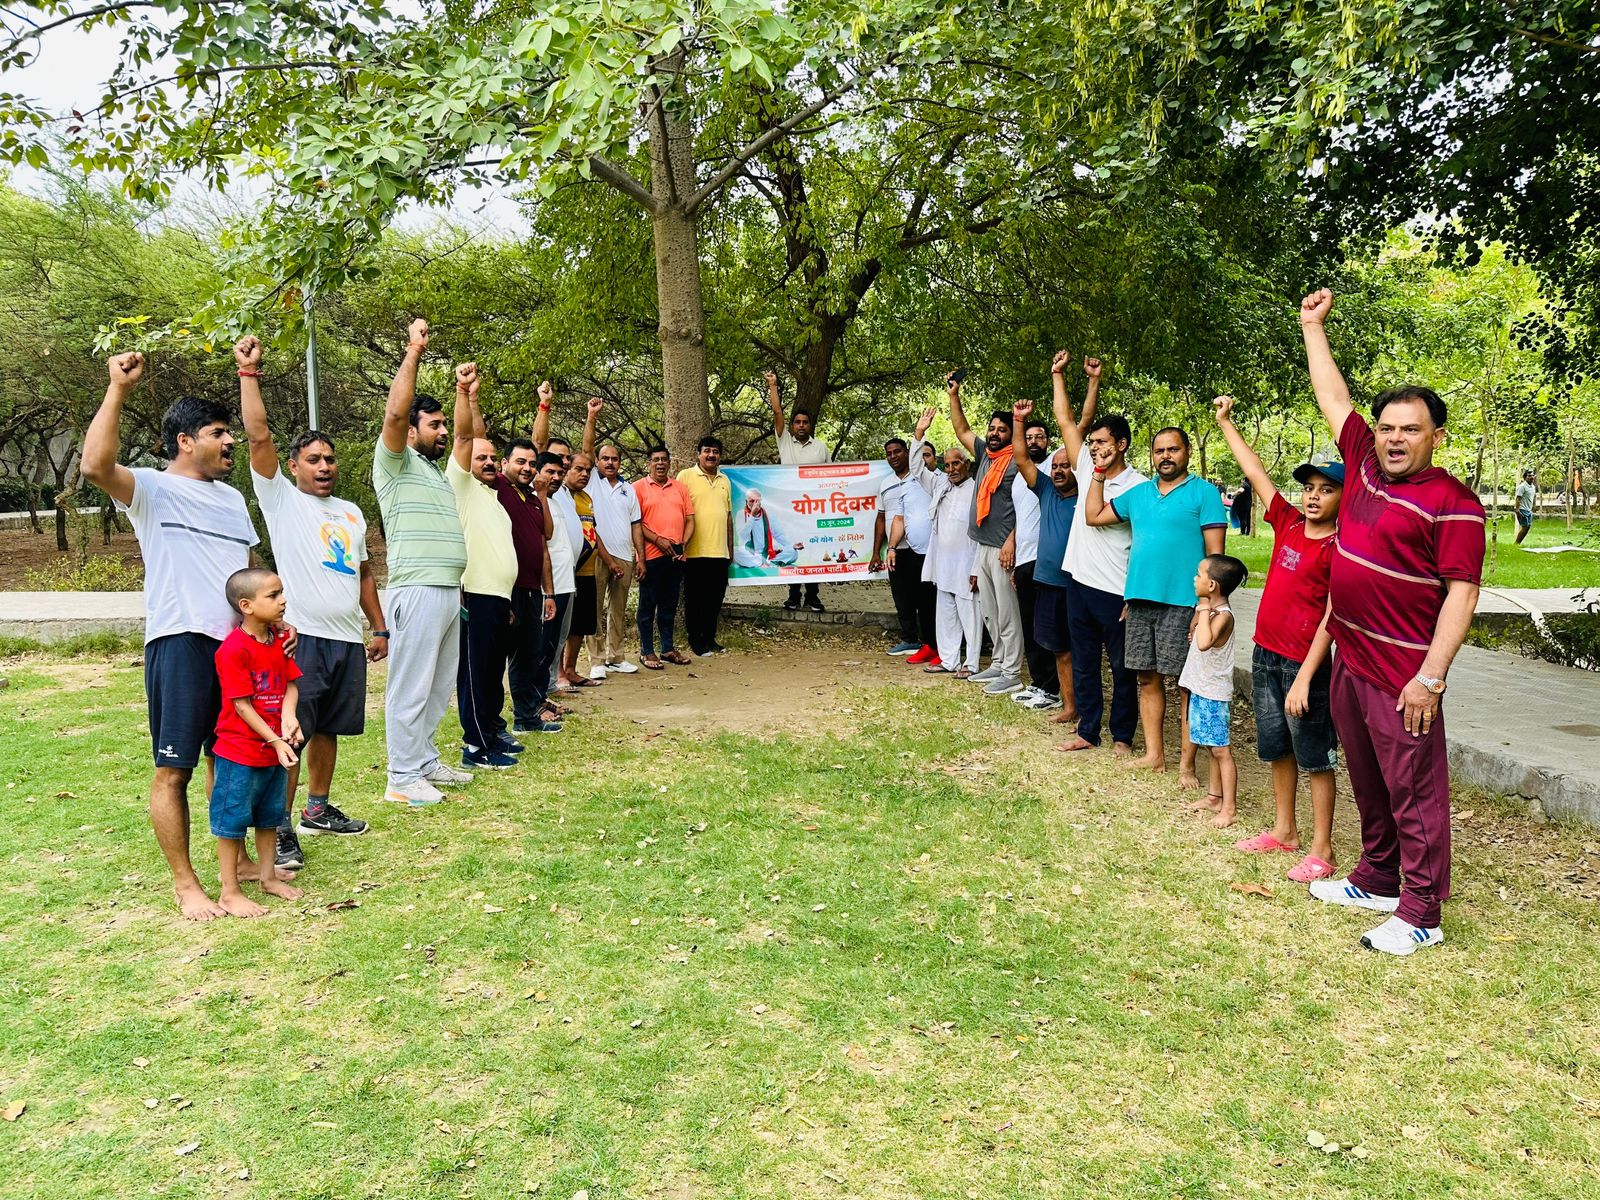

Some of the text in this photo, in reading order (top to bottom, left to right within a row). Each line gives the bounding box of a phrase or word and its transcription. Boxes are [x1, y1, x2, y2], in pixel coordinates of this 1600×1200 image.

[792, 492, 877, 515] योग दिवस
[820, 535, 833, 543] योग
[846, 533, 865, 542] निरोग
[781, 566, 804, 575] भारतीय
[806, 565, 825, 574] जनता
